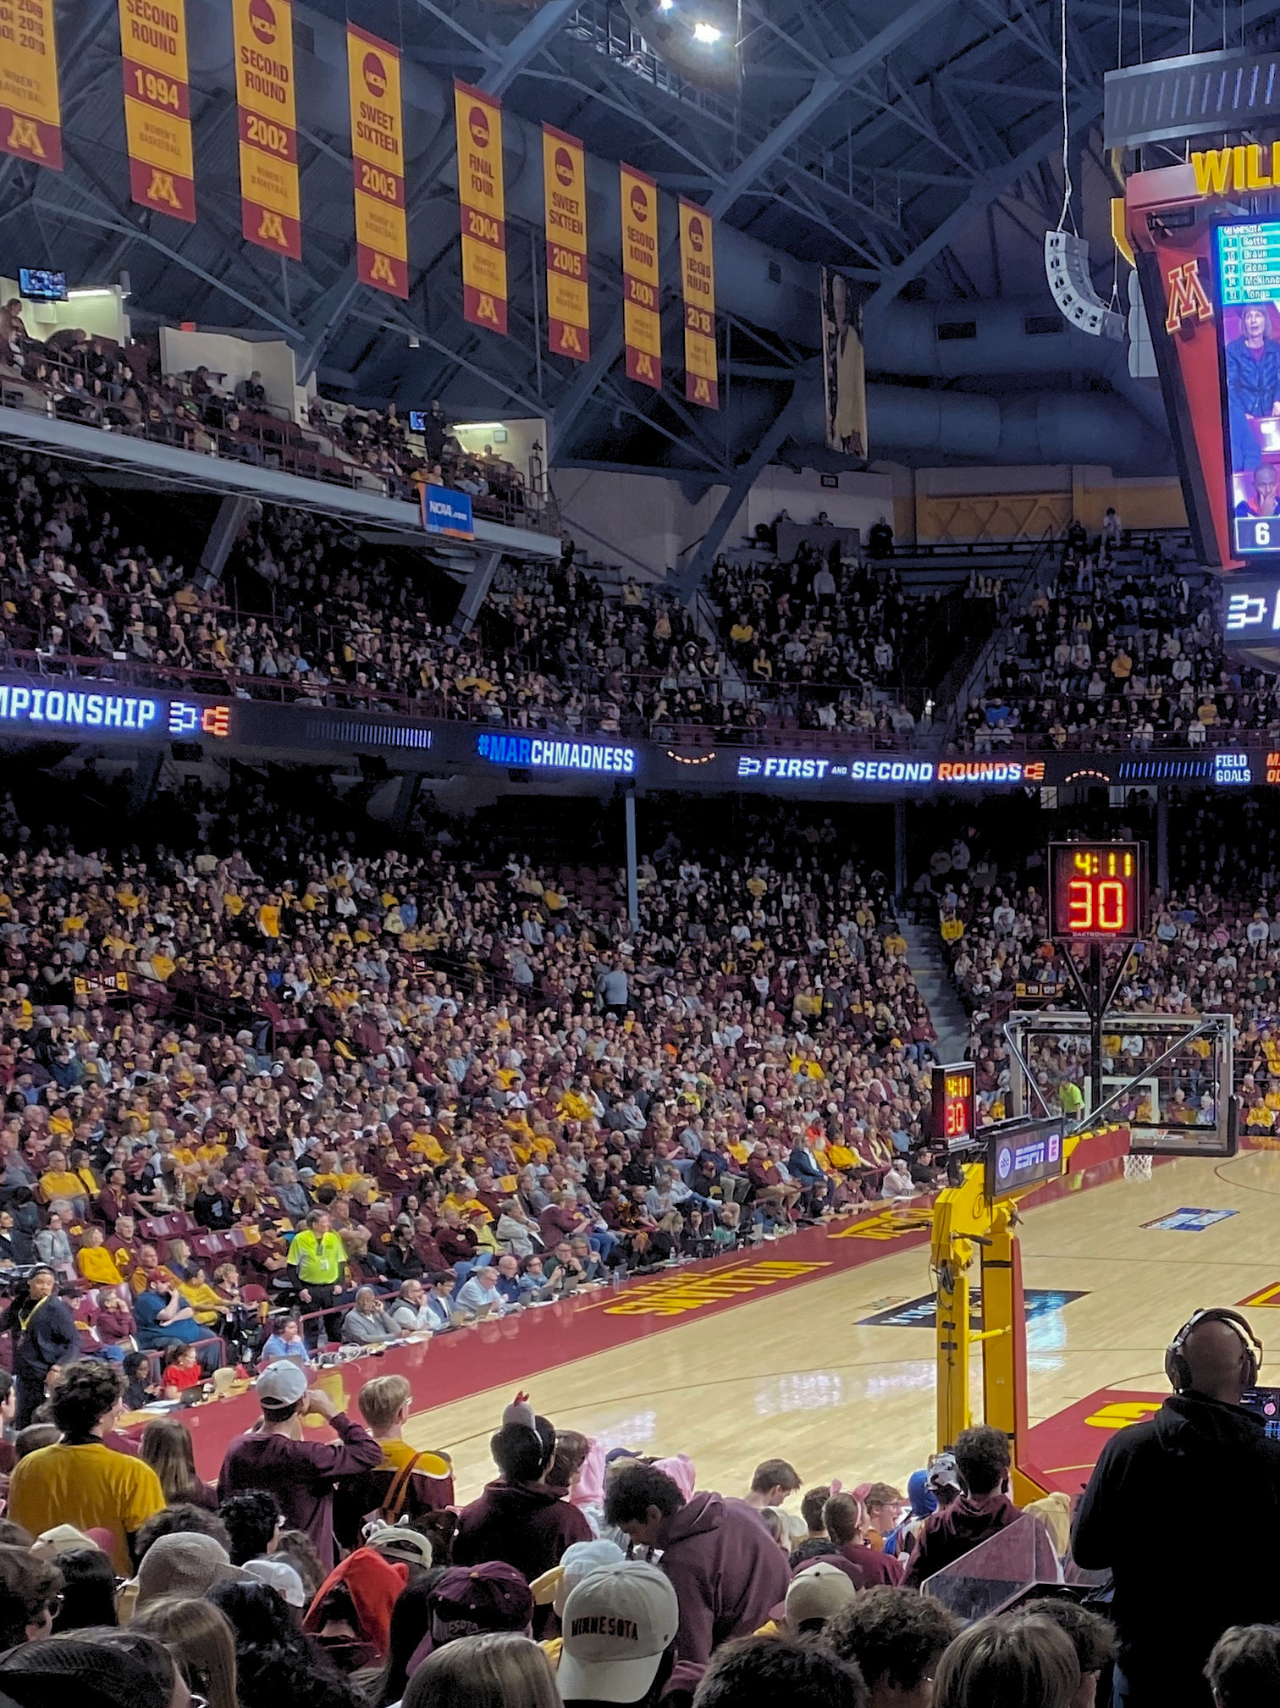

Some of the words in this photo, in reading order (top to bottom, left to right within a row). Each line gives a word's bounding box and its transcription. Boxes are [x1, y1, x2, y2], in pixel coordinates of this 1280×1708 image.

[127, 0, 178, 33] SECOND
[131, 19, 177, 56] ROUND
[241, 46, 289, 83] SECOND
[134, 68, 180, 110] 1994
[245, 69, 286, 104] ROUND
[359, 101, 394, 133] SWEET
[247, 115, 288, 155] 2002
[356, 121, 399, 156] SIXTEEN
[361, 164, 397, 200] 2003
[468, 153, 495, 179] FINAL
[147, 170, 182, 209] M
[471, 174, 494, 199] FOUR
[551, 192, 580, 215] SWEET
[258, 210, 288, 247] M
[468, 211, 500, 244] 2004
[549, 209, 584, 237] SIXTEEN
[369, 255, 397, 288] M
[553, 248, 582, 276] 2005
[476, 293, 500, 324] M
[1165, 259, 1214, 333] M
[1255, 522, 1270, 545] 6
[478, 733, 636, 773] #MARCHMADNESS
[1215, 754, 1247, 767] FIELD
[764, 759, 829, 779] FIRST
[831, 766, 848, 774] AND
[851, 761, 933, 781] SECOND
[937, 762, 1022, 782] ROUNDS
[1215, 768, 1251, 782] GOALS
[1074, 852, 1132, 877] 4:11
[1068, 880, 1125, 930] 30
[947, 1077, 968, 1098] 4:11
[947, 1102, 965, 1134] 30
[1015, 1142, 1045, 1170] ESPN
[571, 1616, 638, 1641] MINNESOTA
